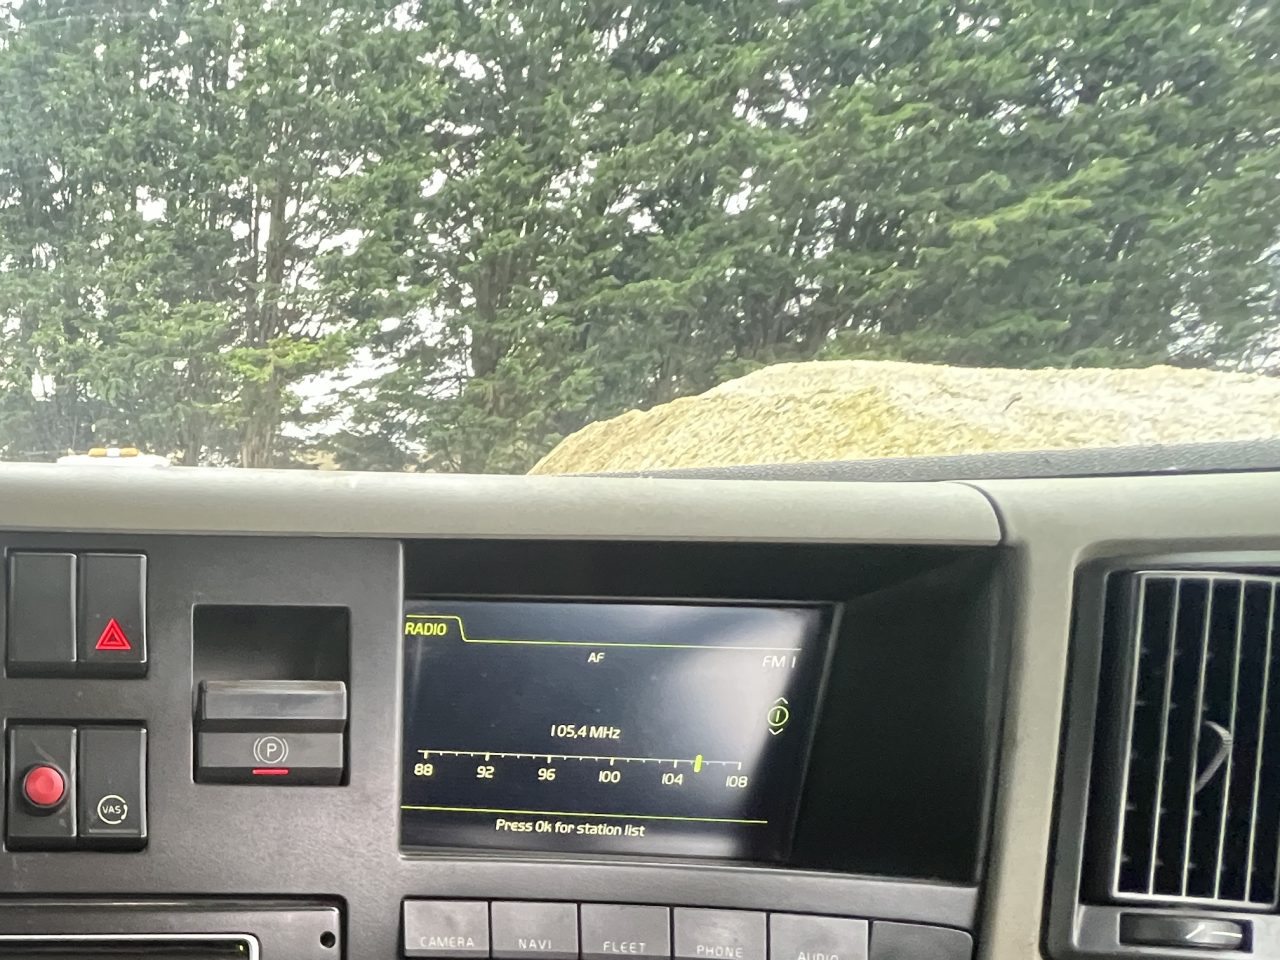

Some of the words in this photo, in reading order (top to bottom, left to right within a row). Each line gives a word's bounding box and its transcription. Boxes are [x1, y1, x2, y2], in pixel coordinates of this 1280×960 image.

[404, 621, 447, 636] RADIO
[587, 652, 606, 663] AF
[761, 655, 786, 668] FM
[550, 724, 588, 739] 105,4
[589, 725, 622, 739] MHz
[413, 763, 434, 776] 88
[476, 766, 495, 779] 92
[537, 768, 556, 781] 96
[598, 770, 622, 783] 100
[661, 772, 684, 786] 104
[725, 775, 748, 788] 108
[102, 805, 122, 814] VAS
[495, 818, 533, 833] Press
[535, 820, 552, 833] Ok
[555, 821, 574, 834] for
[576, 823, 622, 836] station
[624, 824, 646, 837] list
[420, 936, 475, 948] CAMERA
[518, 938, 553, 950] NAVI
[603, 941, 647, 953] FLEET
[697, 945, 743, 959] PHONE
